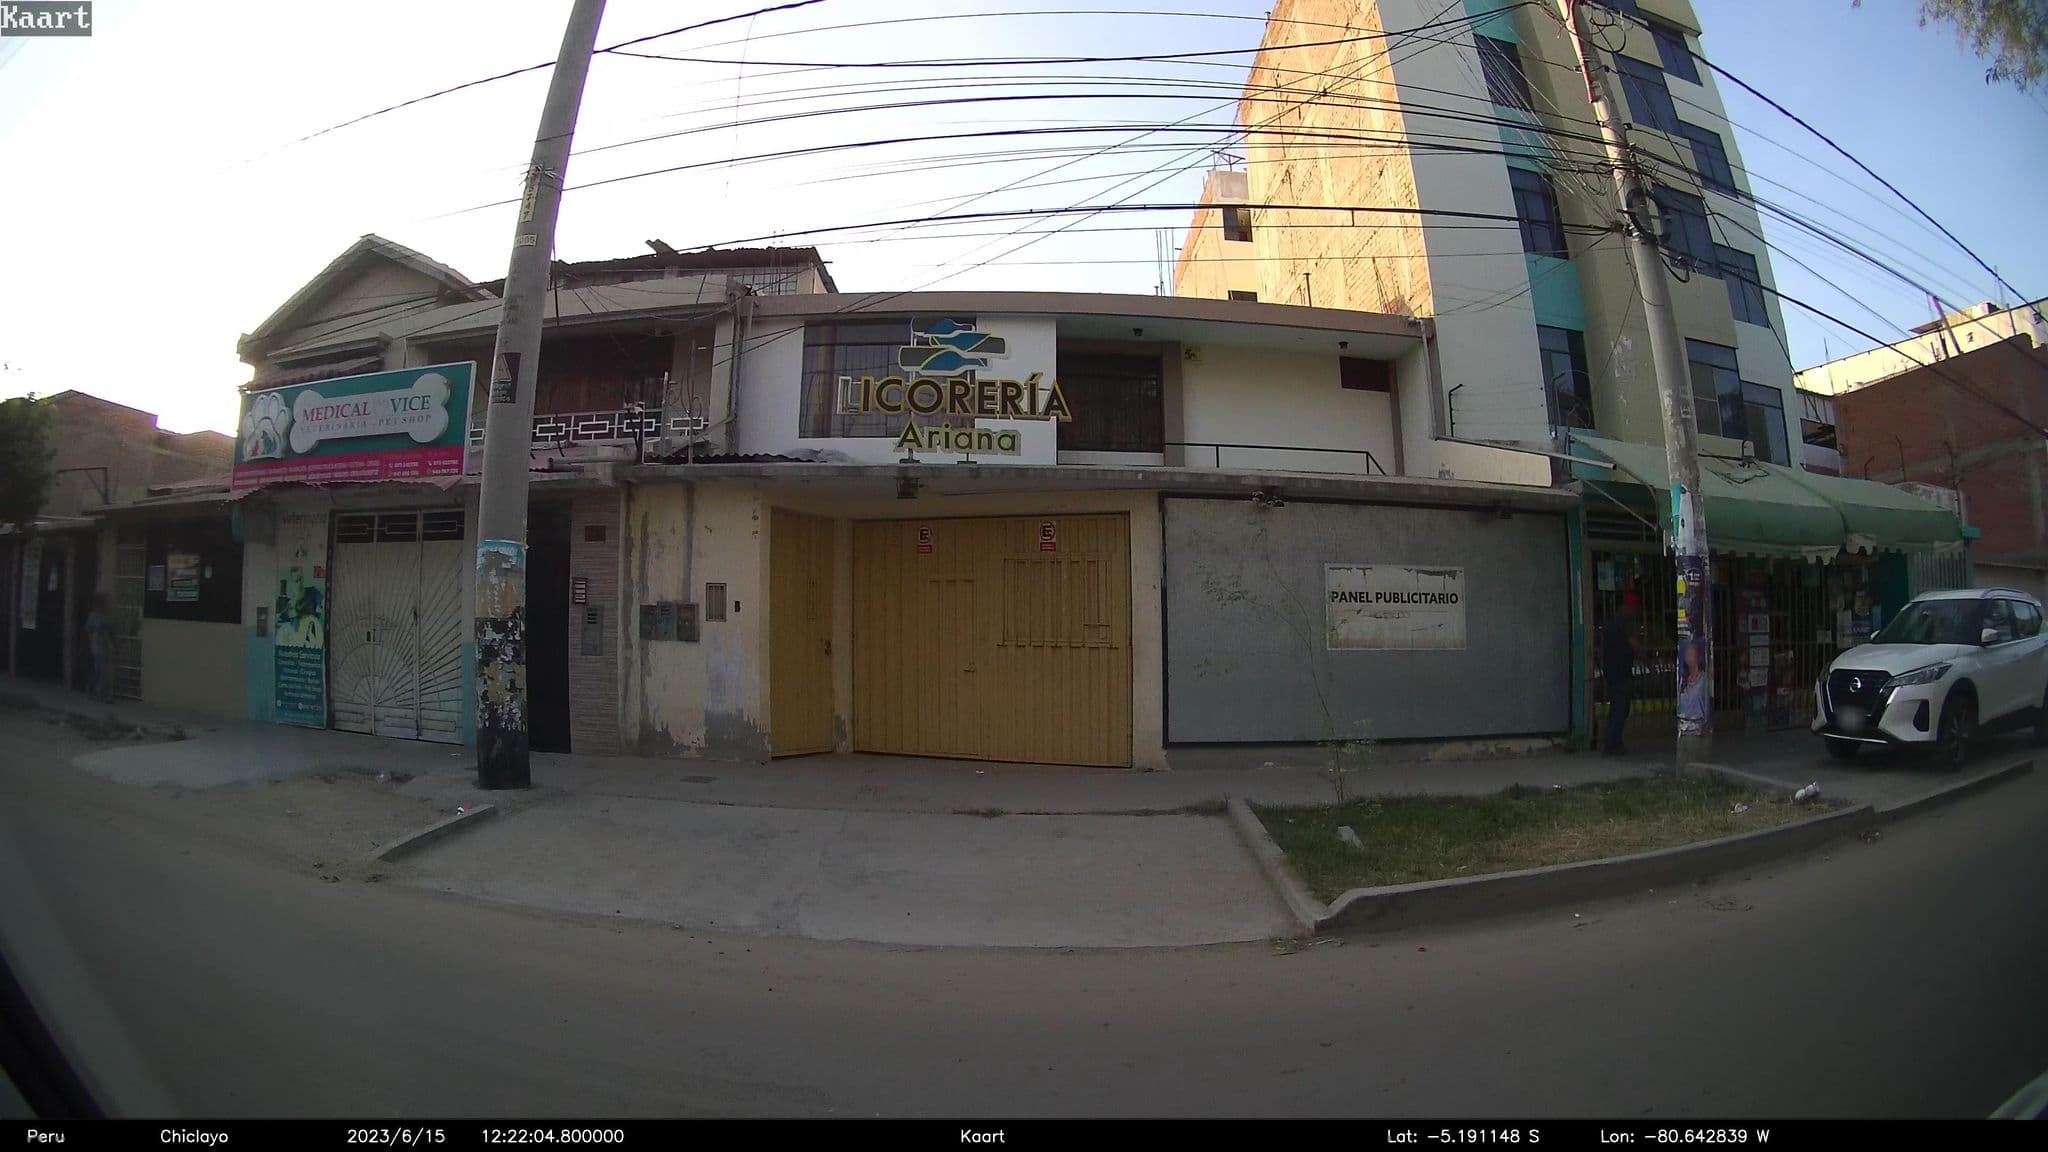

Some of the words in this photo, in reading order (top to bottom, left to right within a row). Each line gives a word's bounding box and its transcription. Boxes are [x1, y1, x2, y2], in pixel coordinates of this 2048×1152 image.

[303, 402, 371, 421] MEDICAL
[837, 372, 1072, 422] LICORERÍA
[895, 417, 1021, 456] Ariana
[1331, 591, 1372, 604] PANEL
[1376, 591, 1459, 604] PUBLICITARIO
